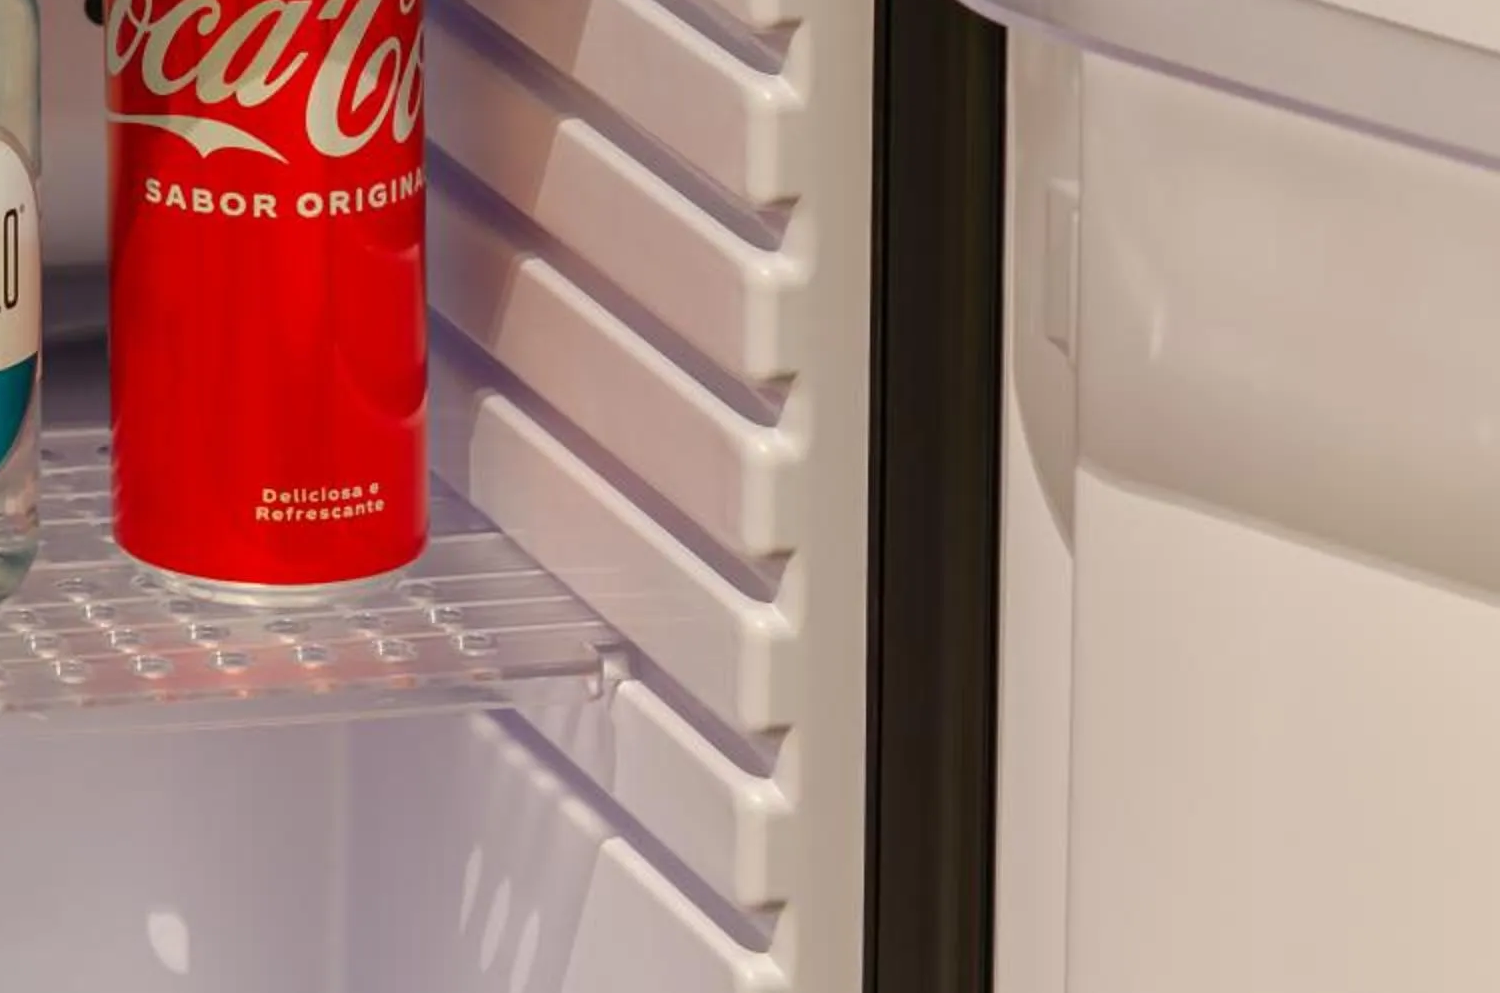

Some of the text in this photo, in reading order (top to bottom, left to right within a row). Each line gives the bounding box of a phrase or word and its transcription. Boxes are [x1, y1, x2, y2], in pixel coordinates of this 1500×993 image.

[144, 177, 279, 219] SABOR
[261, 482, 380, 503] Deliciosa e
[255, 498, 385, 522] Refrescante
